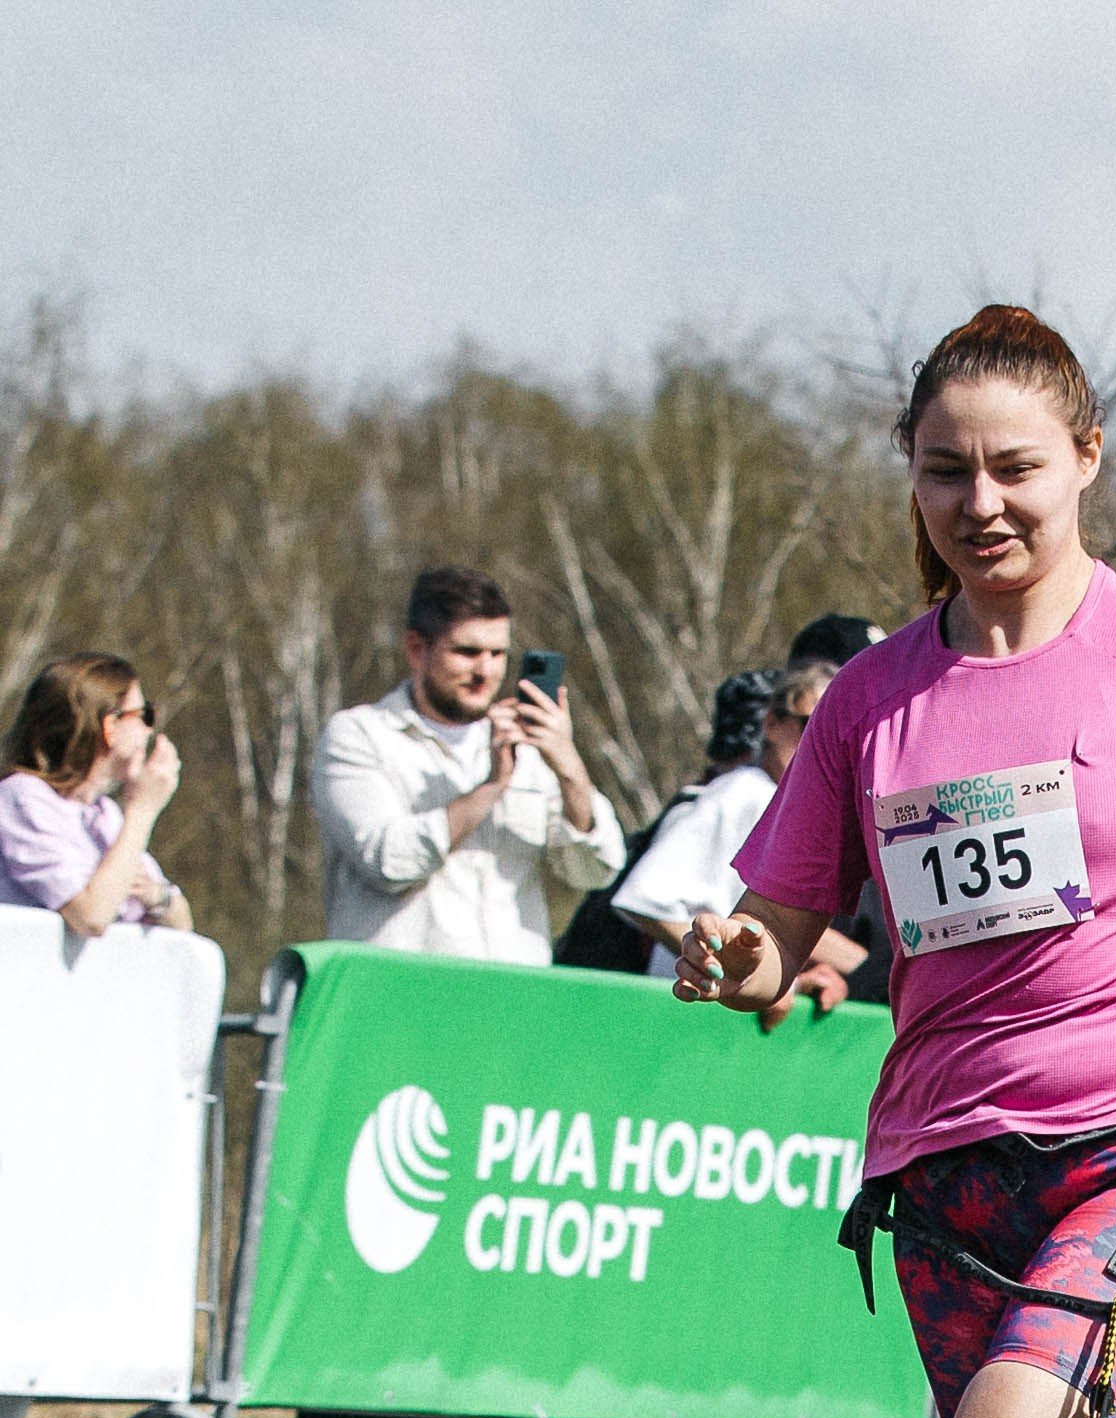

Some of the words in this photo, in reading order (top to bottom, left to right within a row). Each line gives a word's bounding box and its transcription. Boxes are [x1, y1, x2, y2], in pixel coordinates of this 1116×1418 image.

[936, 775, 995, 800] КРОСС
[938, 783, 1015, 814] БЫСТРЫЙ
[1021, 784, 1032, 796] 2
[921, 827, 1033, 906] 135
[475, 1104, 598, 1190] РИА
[463, 1193, 664, 1283] СПОРТ
